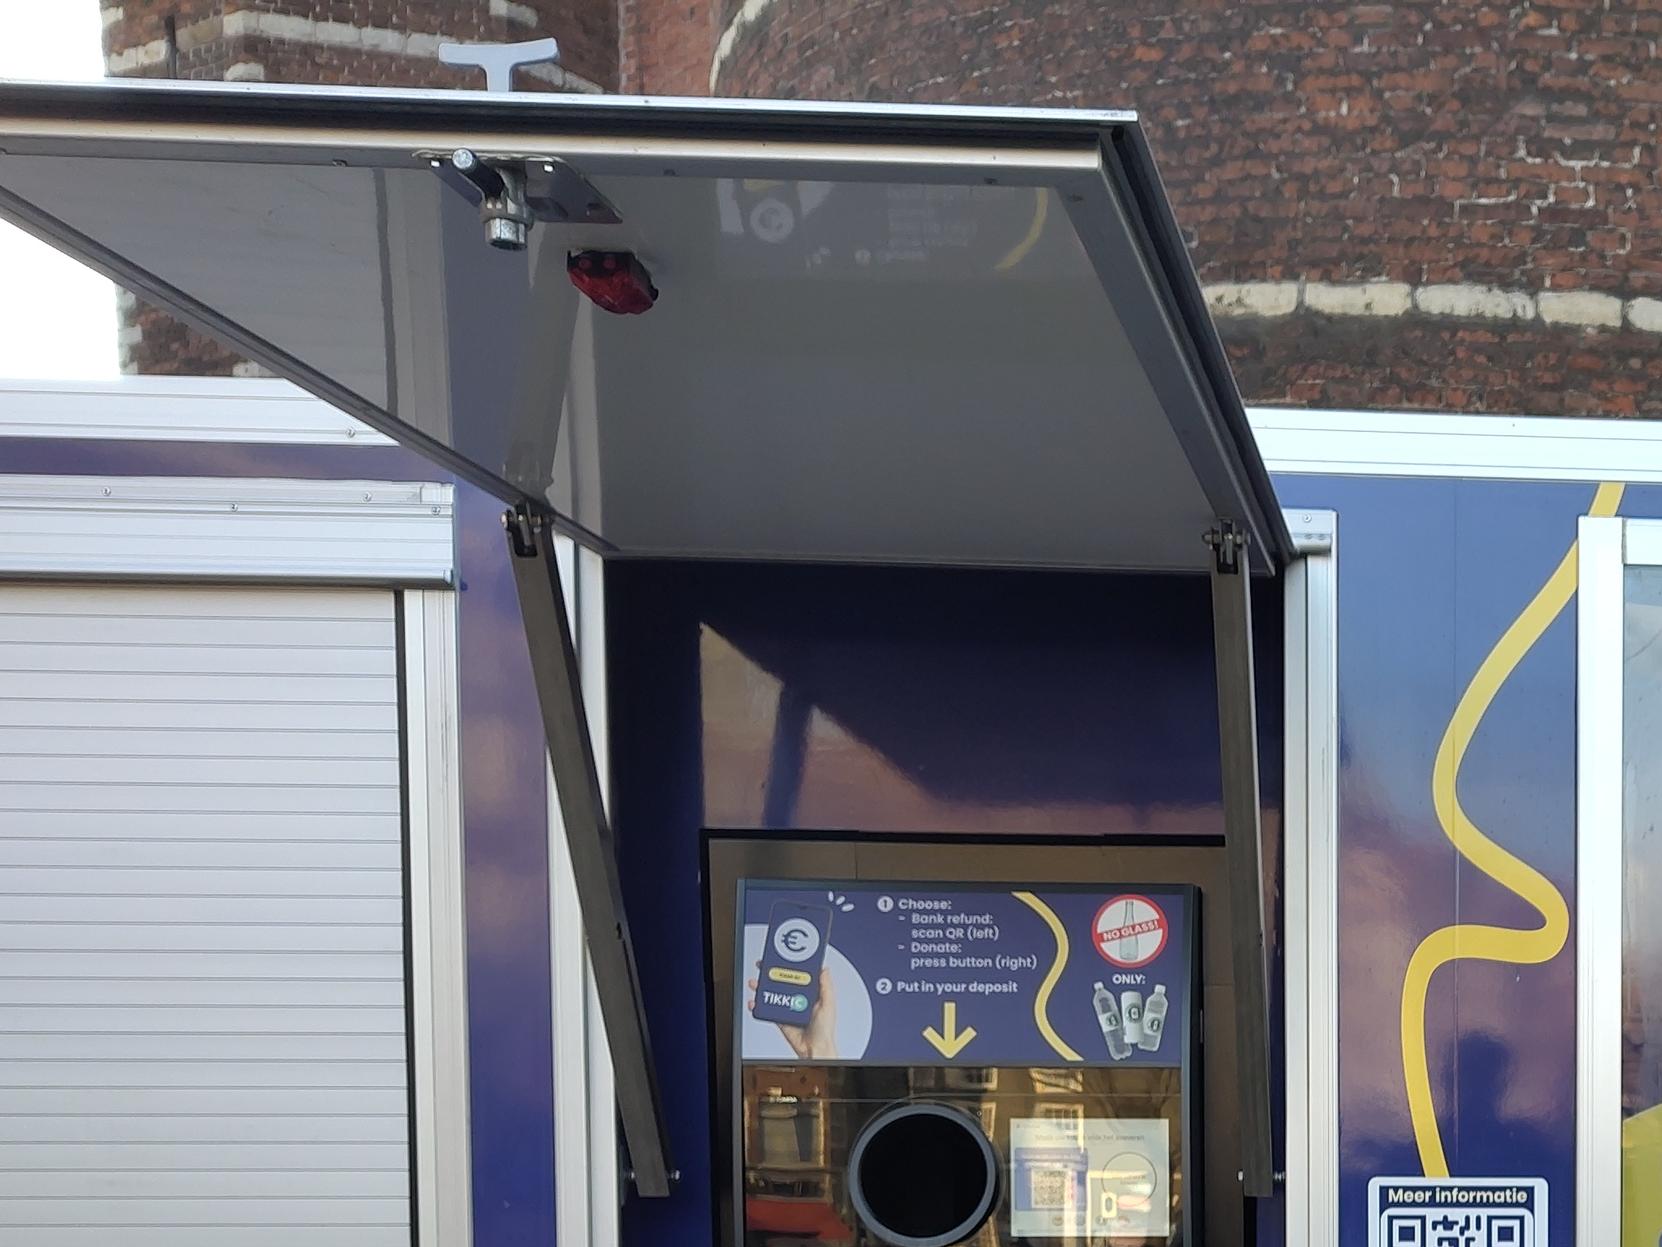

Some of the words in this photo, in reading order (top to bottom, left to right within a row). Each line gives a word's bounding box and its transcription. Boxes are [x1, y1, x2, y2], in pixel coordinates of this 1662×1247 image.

[898, 899, 952, 910] Choose:
[911, 913, 944, 925] Bank
[947, 913, 993, 925] refund:
[911, 928, 943, 939] scan
[946, 928, 964, 939] QR
[967, 925, 999, 941] (left)
[1103, 930, 1120, 942] NO
[1121, 919, 1158, 937] GLASS!
[911, 941, 962, 953] Donate:
[911, 957, 946, 970] press
[950, 956, 992, 968] button
[995, 954, 1037, 971] (right)
[1112, 973, 1146, 985] ONLY:
[897, 982, 918, 993] Put
[921, 980, 934, 993] in
[937, 983, 966, 995] your
[968, 980, 1018, 995] deposit
[1388, 1188, 1432, 1203] Meer
[1435, 1186, 1528, 1203] informatie
